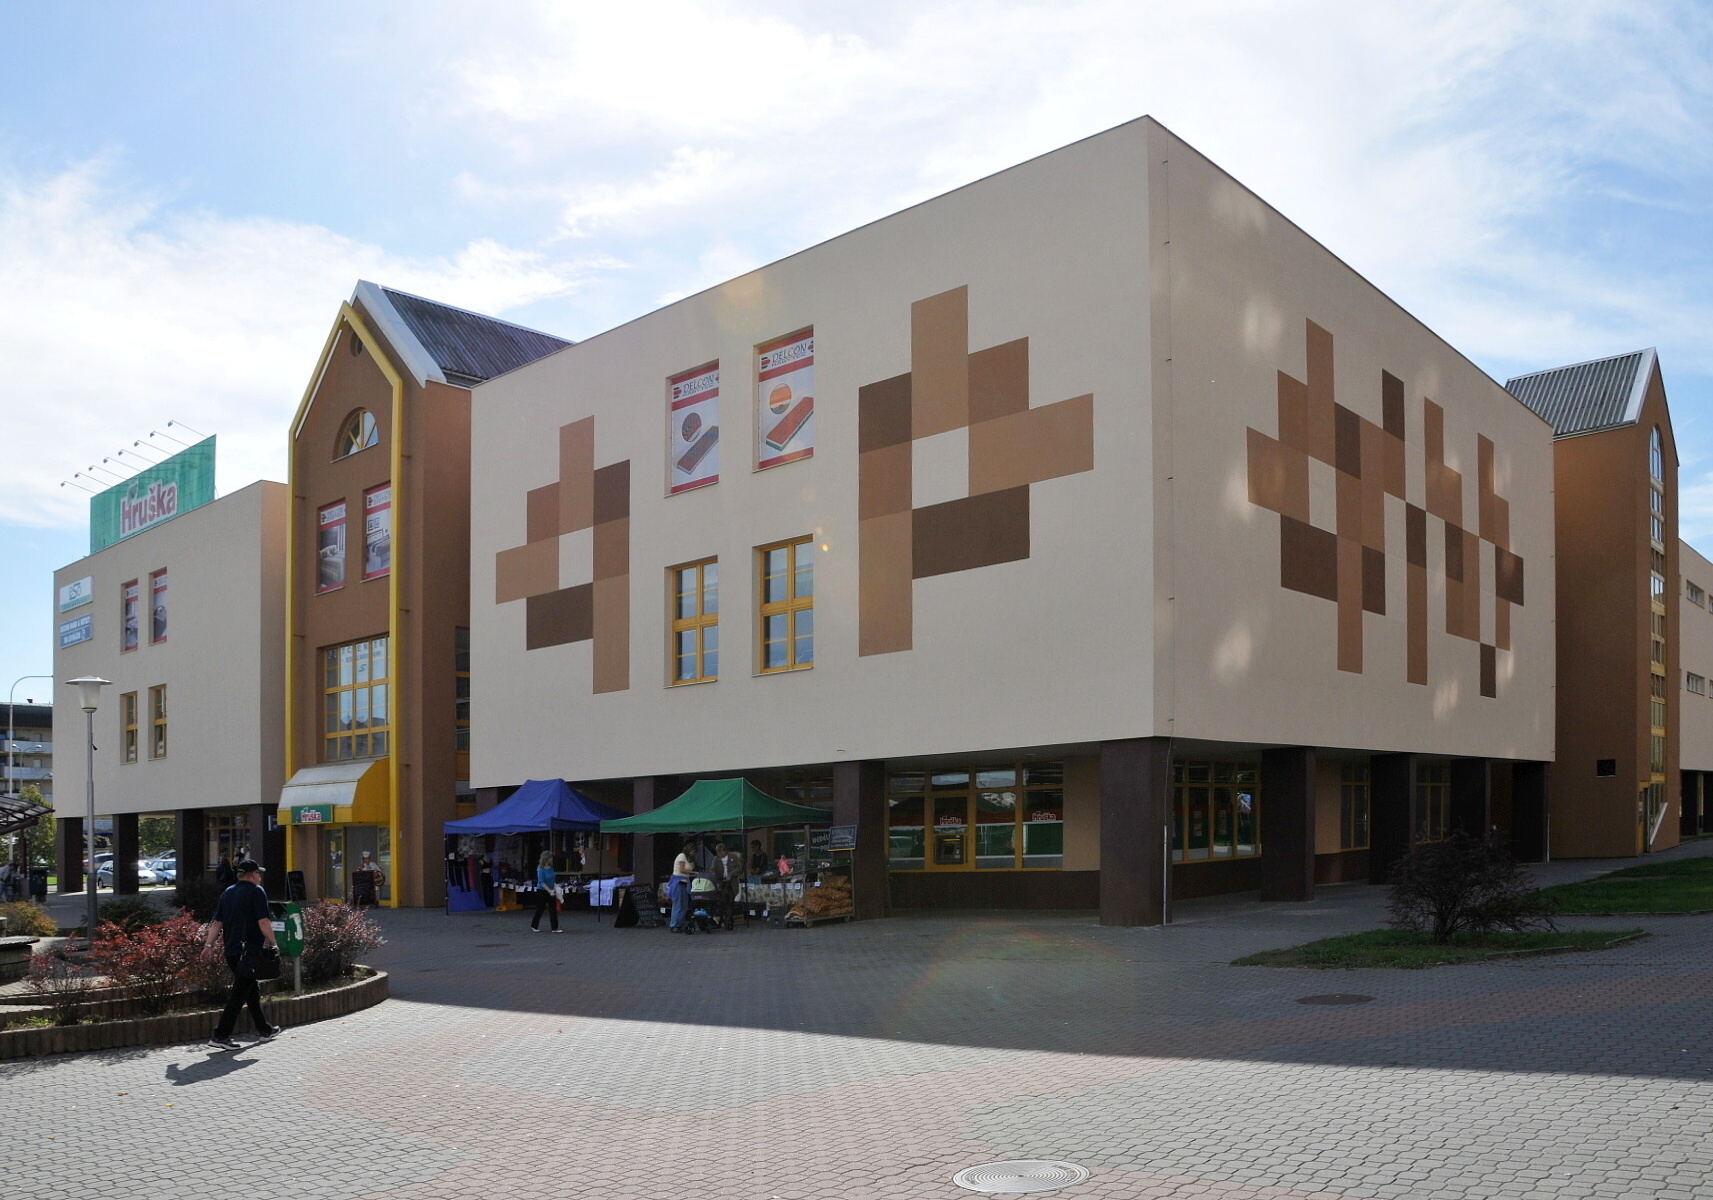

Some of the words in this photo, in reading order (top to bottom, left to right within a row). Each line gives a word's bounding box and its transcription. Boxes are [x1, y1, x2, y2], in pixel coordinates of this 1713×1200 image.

[771, 343, 807, 363] DELCON
[683, 374, 715, 393] DELCON
[121, 483, 176, 534] Hruška
